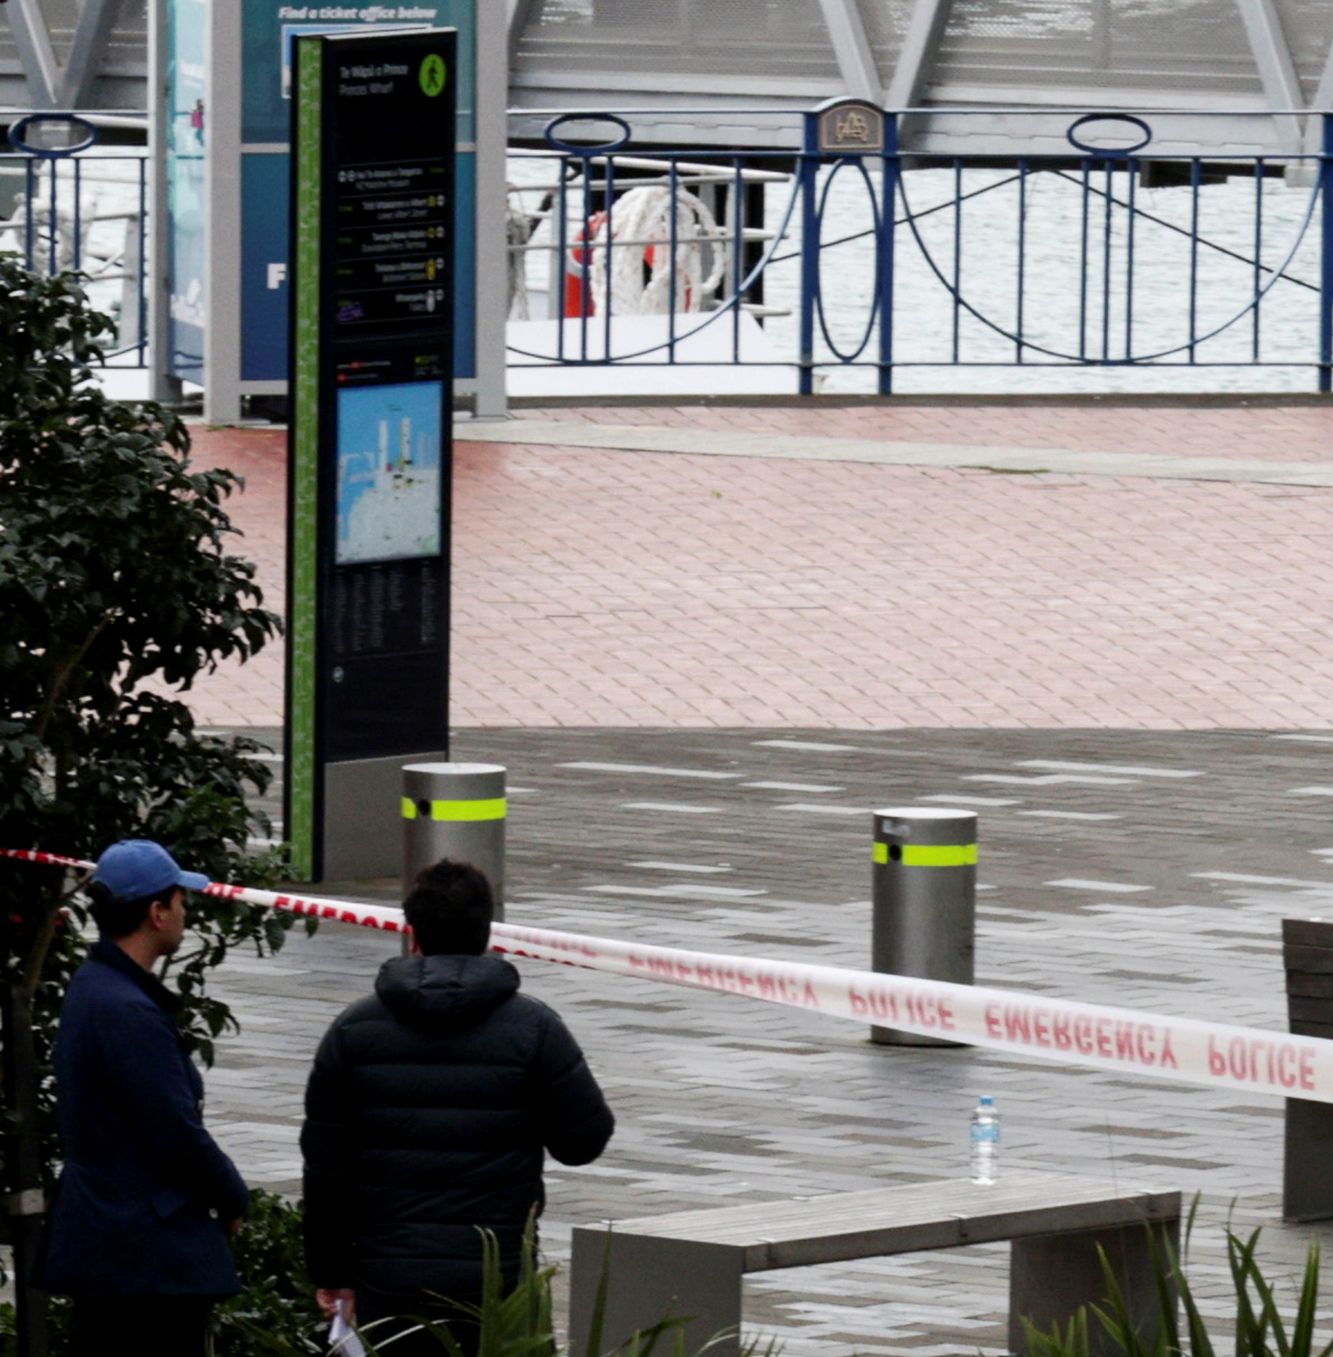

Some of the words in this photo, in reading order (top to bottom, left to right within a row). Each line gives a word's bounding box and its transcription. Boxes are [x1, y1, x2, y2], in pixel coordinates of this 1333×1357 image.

[278, 6, 308, 19] Find
[308, 8, 317, 19] a
[319, 6, 357, 19] ticket
[358, 6, 396, 22] office
[397, 6, 437, 19] below
